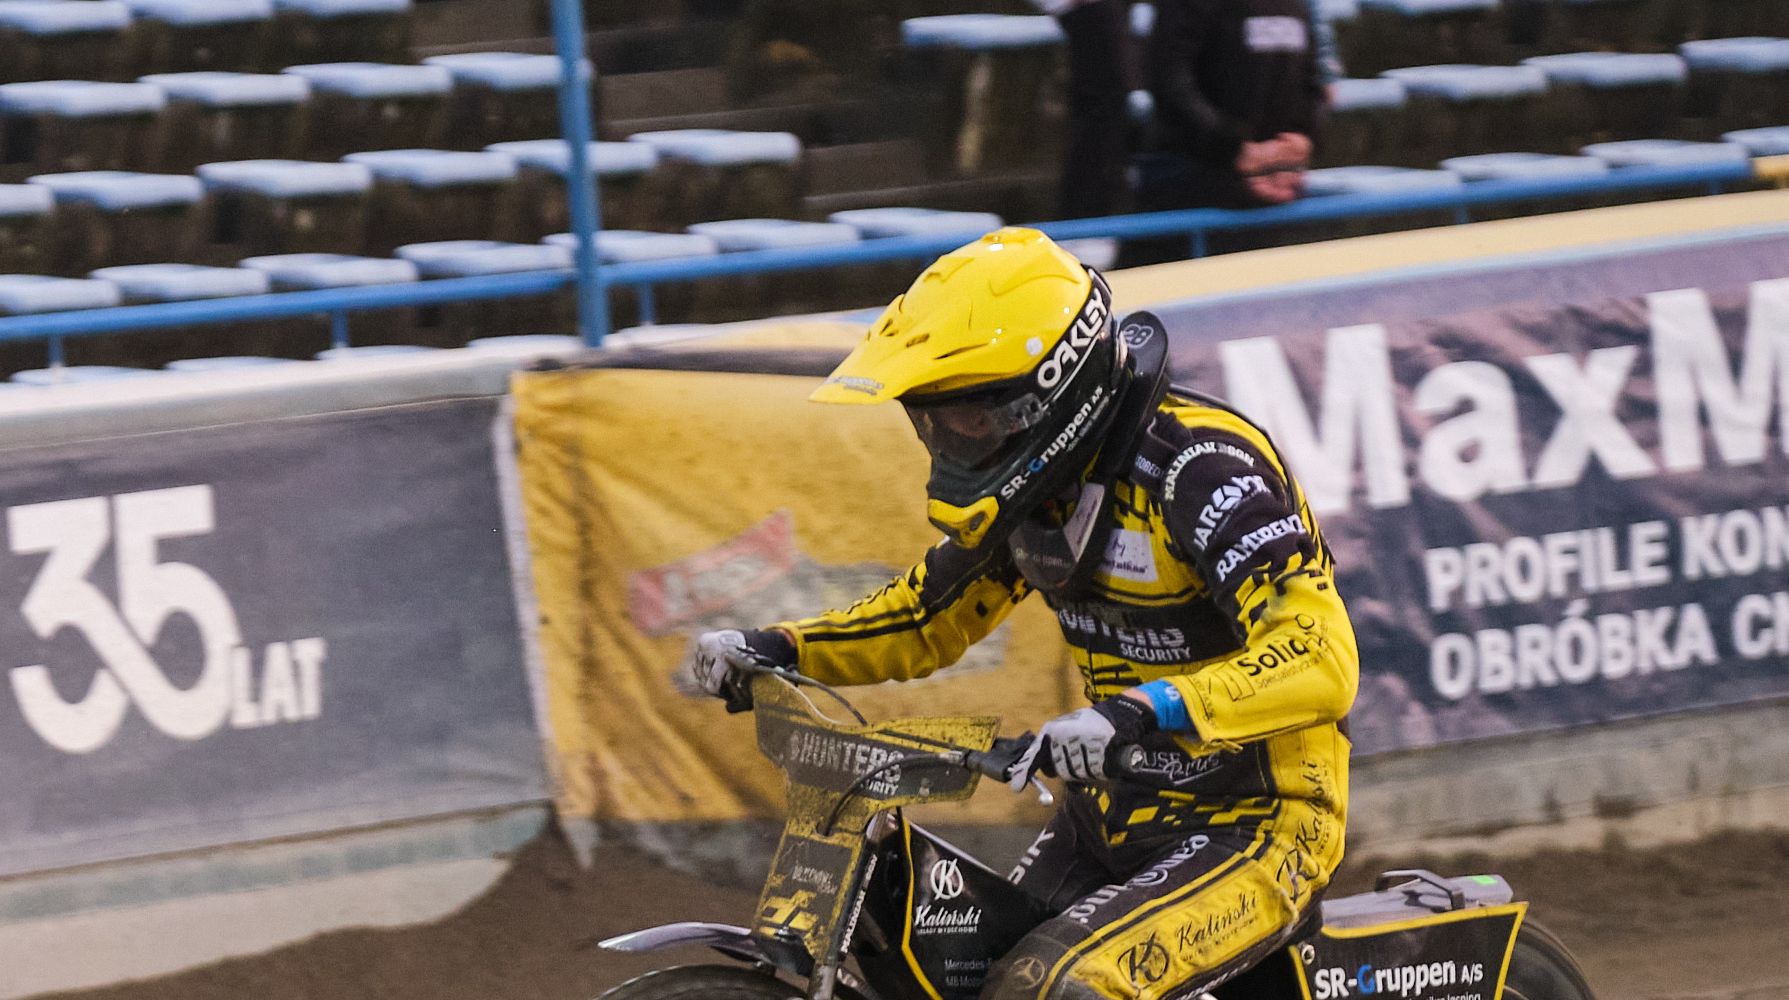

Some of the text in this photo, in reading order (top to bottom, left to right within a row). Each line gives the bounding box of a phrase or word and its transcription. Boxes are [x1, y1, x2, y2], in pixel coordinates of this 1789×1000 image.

[1037, 287, 1108, 390] OAKLEY
[1122, 322, 1155, 349] 28
[1000, 402, 1092, 500] SR-Gruppen
[1425, 520, 1670, 610] PROFILE
[10, 484, 327, 754] 35 LAT
[1119, 642, 1192, 662] SECURITY
[1431, 590, 1789, 700] OBRÓBKA C
[1315, 960, 1484, 1000] SR-Gruppen A/S
